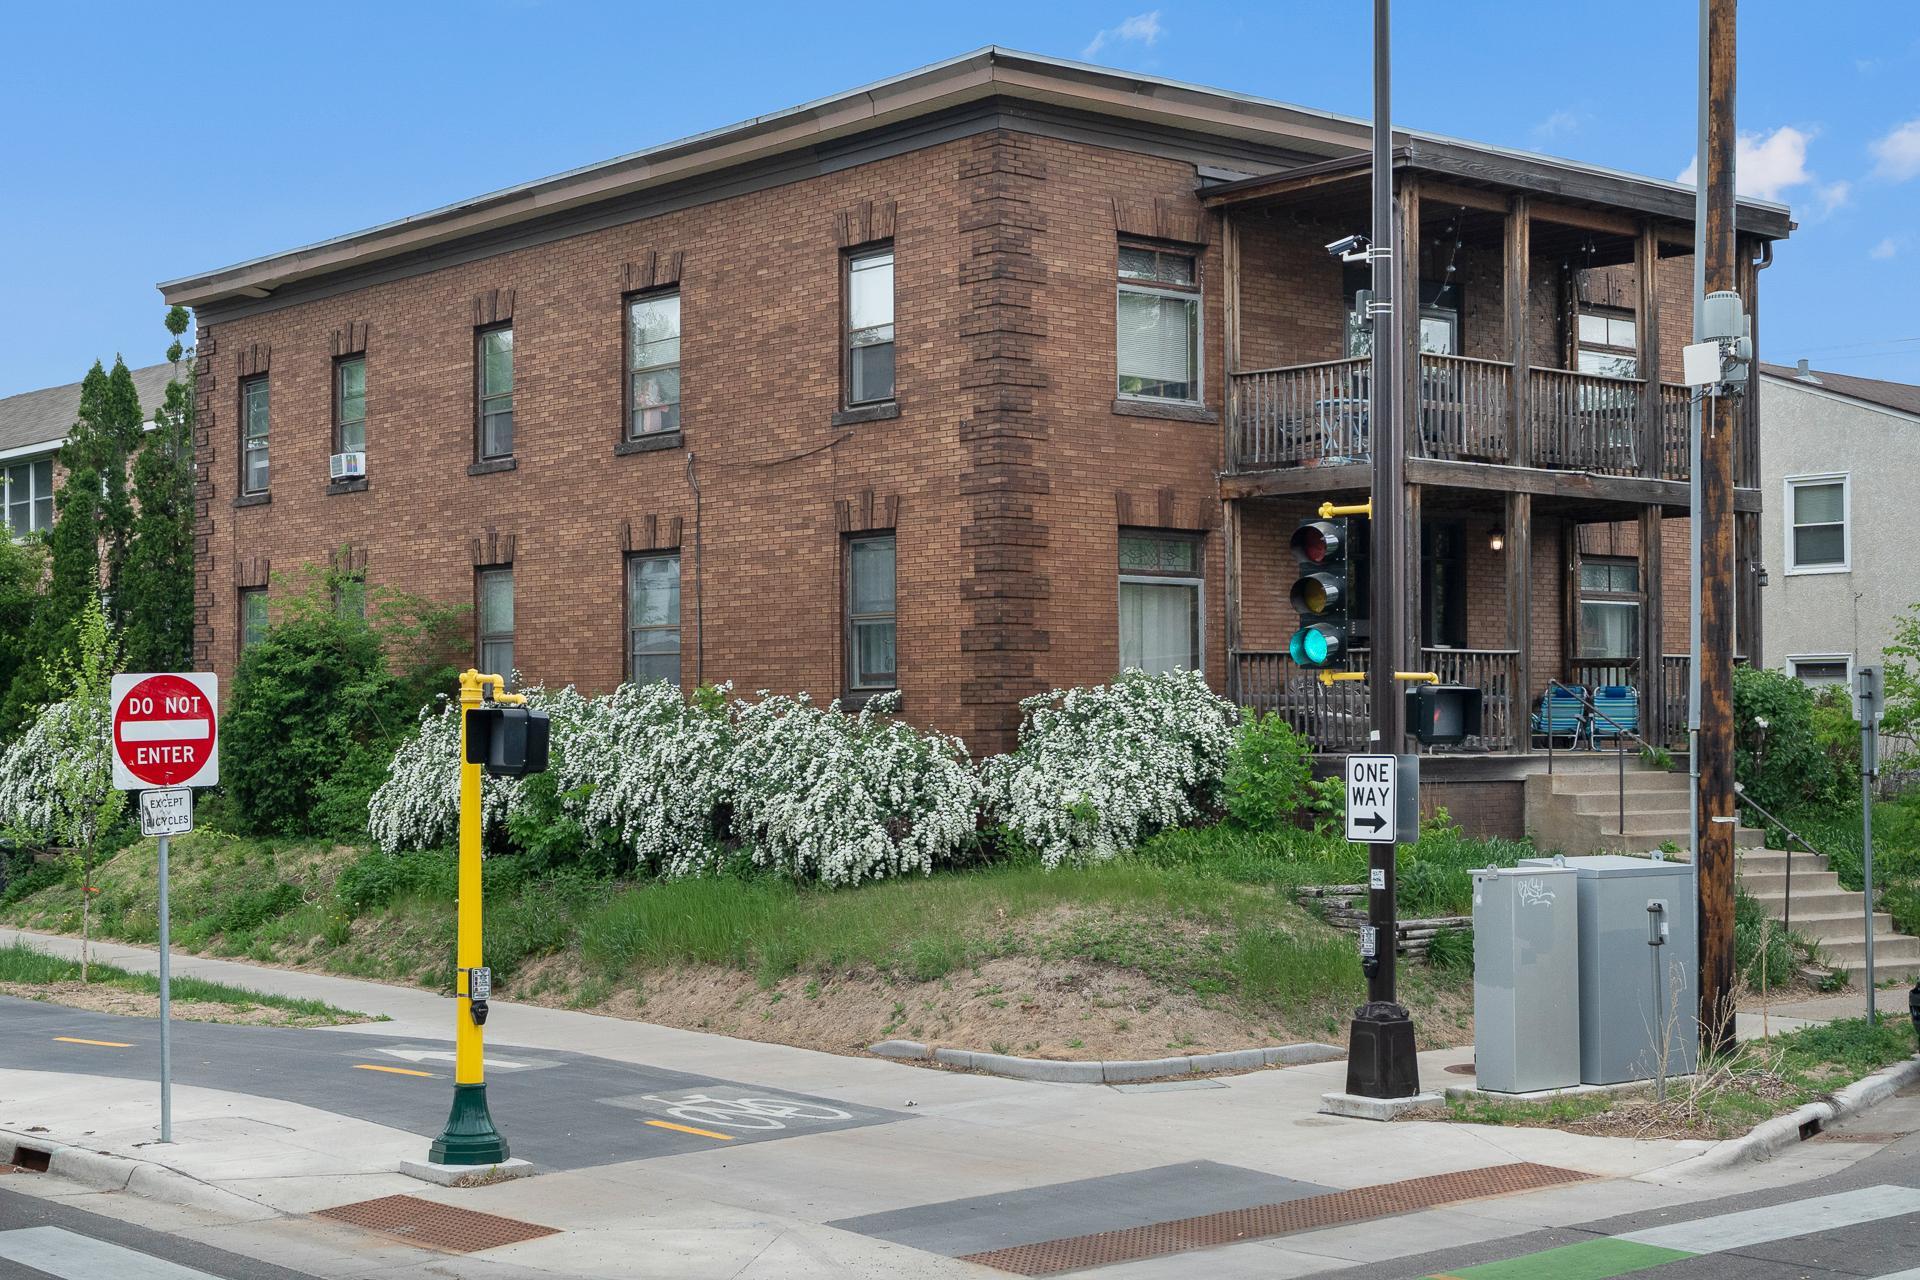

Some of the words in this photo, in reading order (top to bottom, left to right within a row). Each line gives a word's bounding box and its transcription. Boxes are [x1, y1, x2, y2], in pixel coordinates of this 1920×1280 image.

[129, 697, 153, 715] DO
[165, 696, 201, 714] NOT
[137, 746, 194, 765] ENTER
[1354, 763, 1389, 783] ONE
[150, 797, 184, 809] EXCEPT
[1352, 786, 1390, 807] WAY
